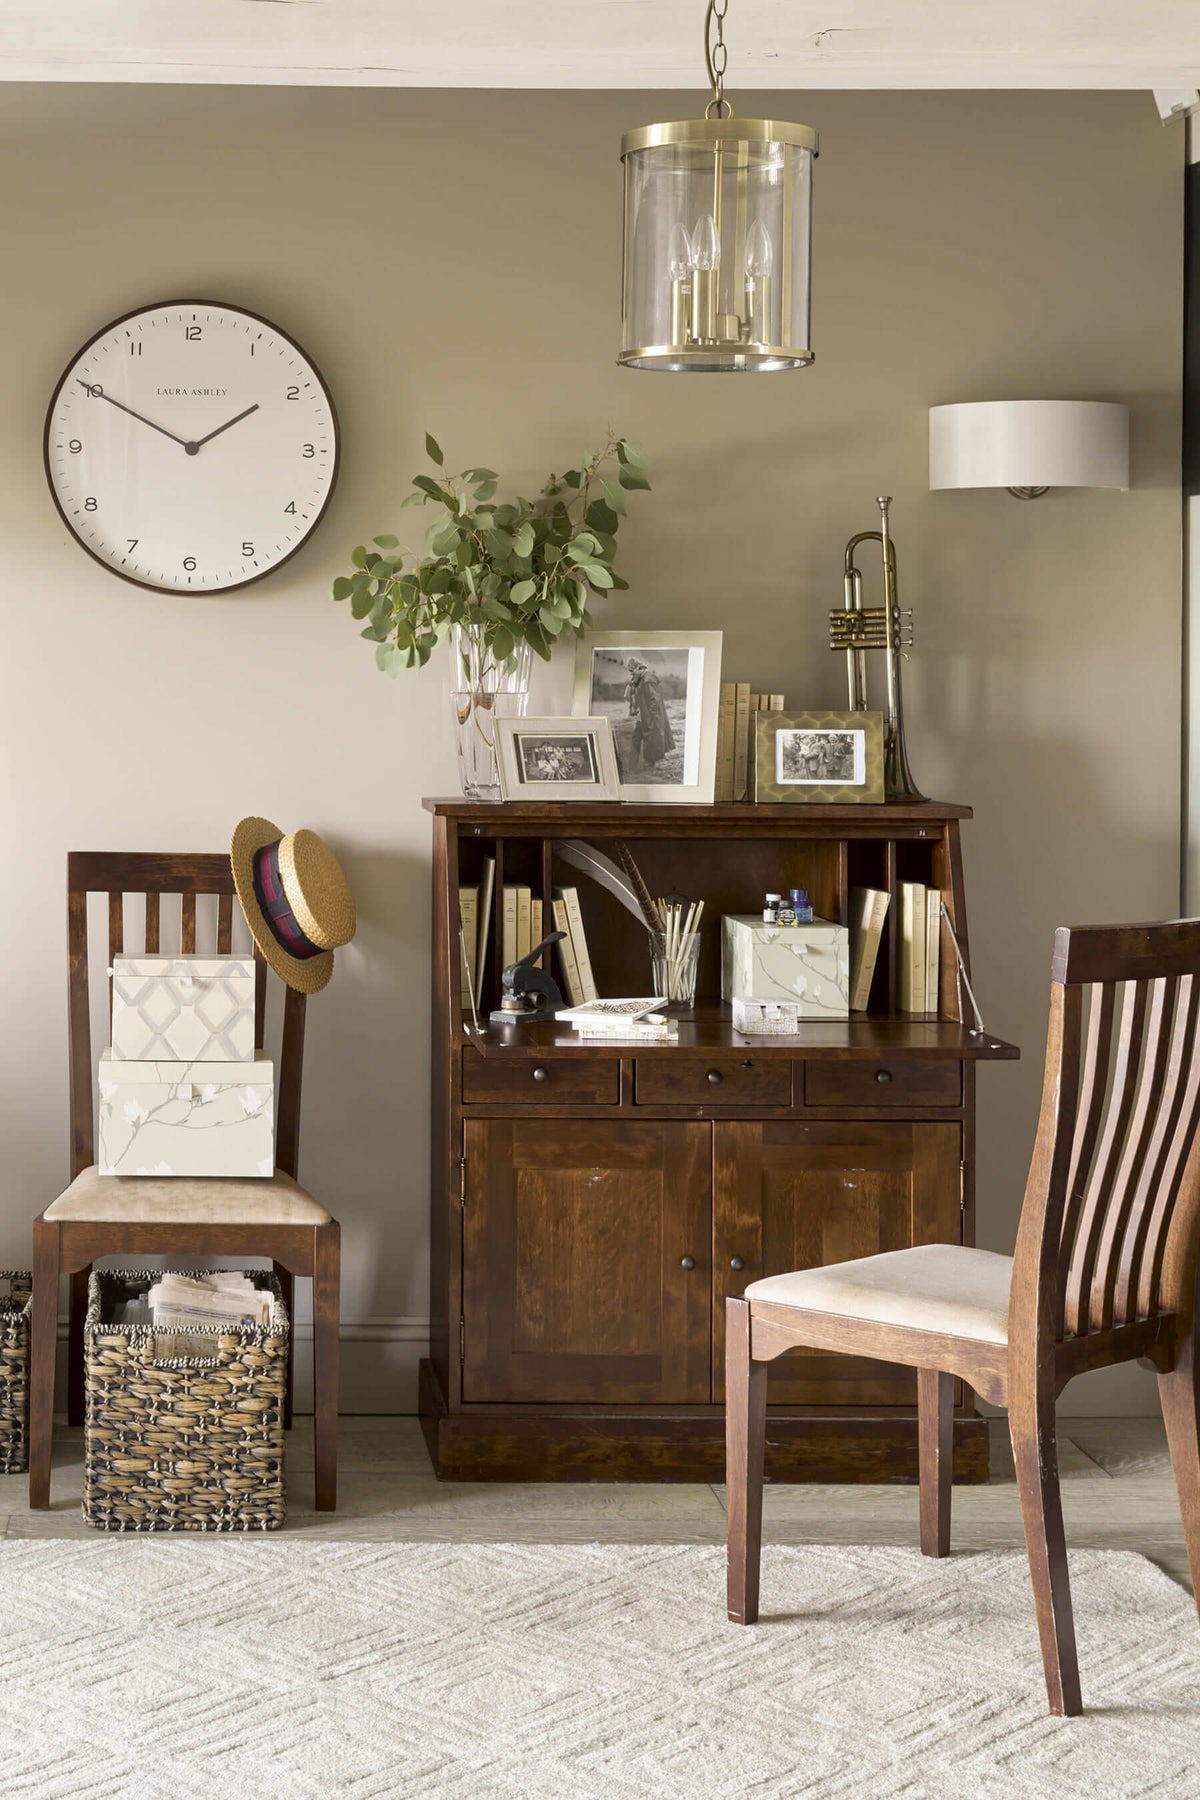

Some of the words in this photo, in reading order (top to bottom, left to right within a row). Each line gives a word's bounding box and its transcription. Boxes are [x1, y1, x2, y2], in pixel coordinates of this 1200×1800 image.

[185, 326, 202, 341] 12
[131, 342, 142, 356] 11
[86, 384, 103, 398] 10
[157, 388, 188, 396] LAURA
[191, 388, 228, 397] ASHLEY
[286, 385, 300, 401] 2
[69, 439, 82, 454] 9
[302, 443, 315, 459] 3
[84, 497, 98, 512] 8
[284, 501, 298, 515] 4
[127, 539, 139, 554] 7
[241, 542, 255, 557] 5
[183, 556, 197, 571] 6
